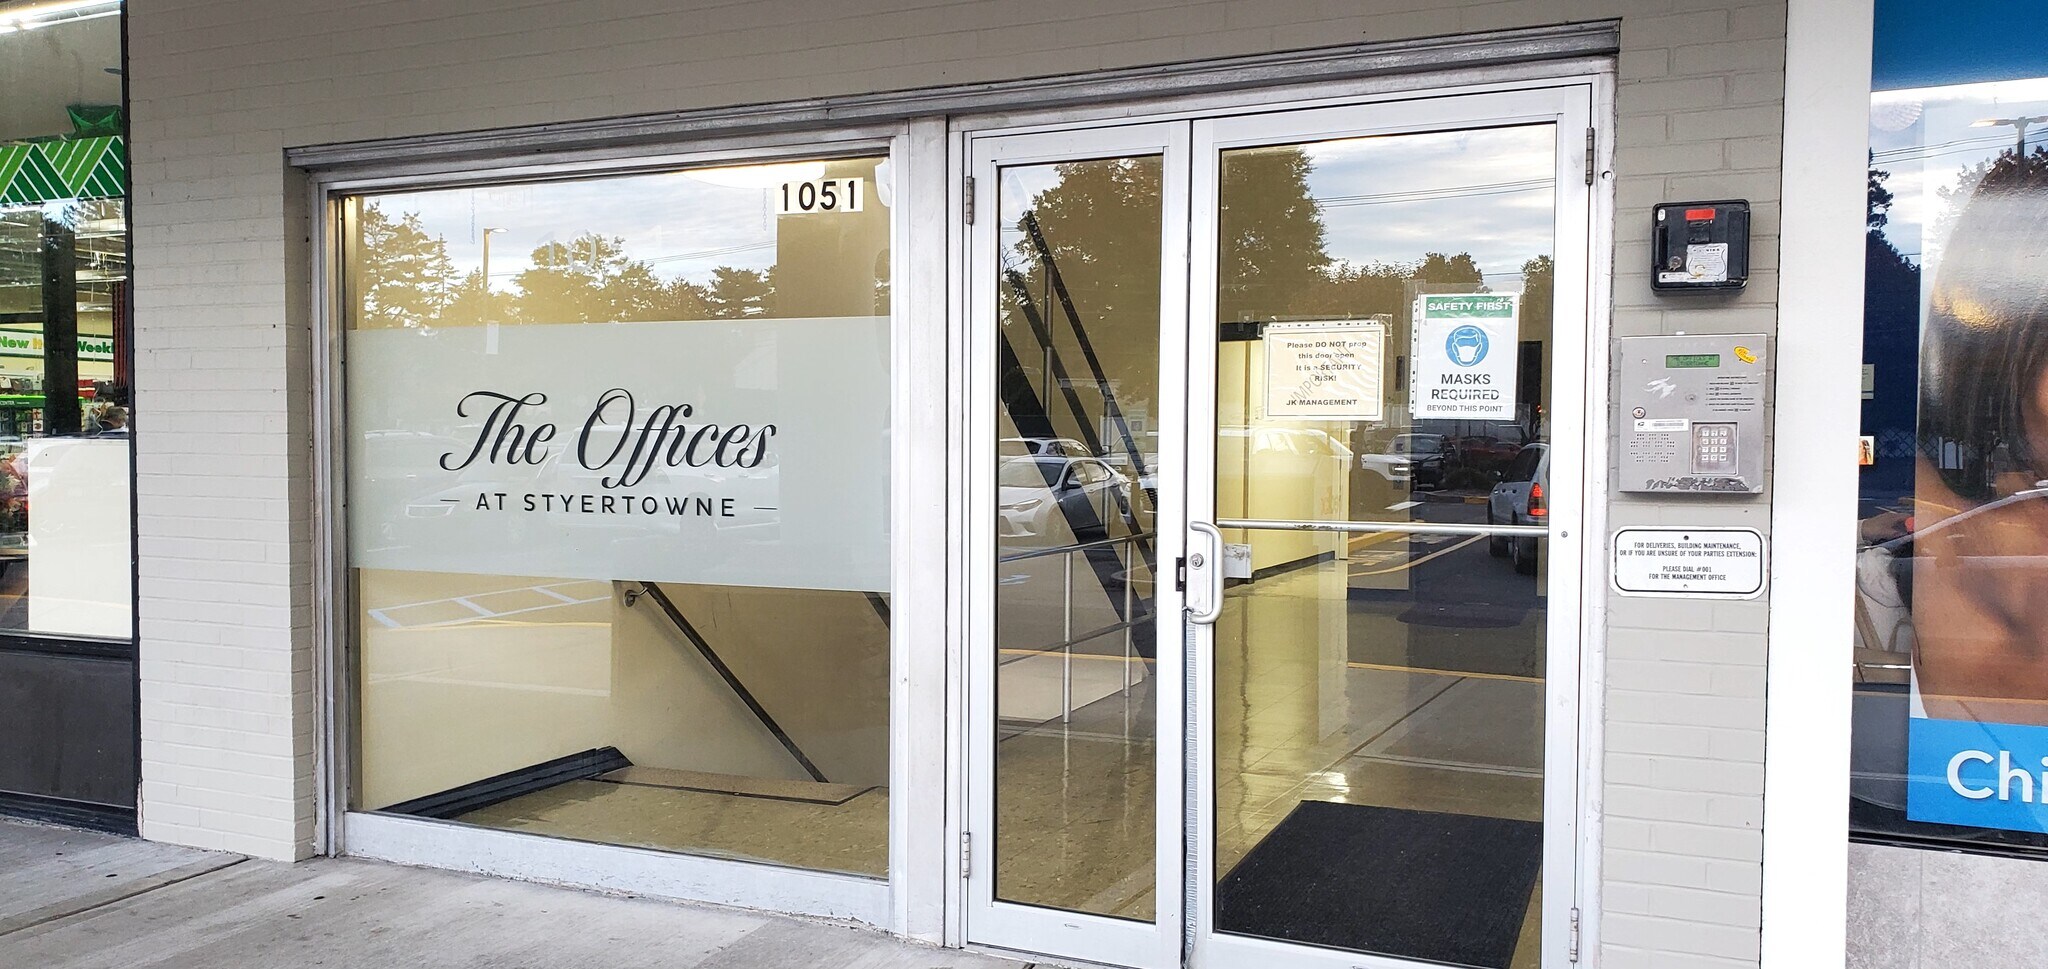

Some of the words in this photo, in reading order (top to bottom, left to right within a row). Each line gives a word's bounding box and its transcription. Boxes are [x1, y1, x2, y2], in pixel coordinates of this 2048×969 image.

[781, 180, 855, 212] 1051
[1428, 302, 1474, 311] SAFETY
[1476, 301, 1511, 310] FIRST
[0, 335, 30, 349] New
[1441, 373, 1491, 385] MASKS
[1431, 388, 1500, 401] REQUIRED
[1427, 404, 1458, 412] BEYOND
[1460, 404, 1477, 412] THIS
[439, 391, 556, 471] The
[577, 388, 777, 489] Offices
[476, 493, 507, 511] AT
[524, 493, 736, 517] STYERTOWNE
[1646, 542, 1676, 550] DELIVERIES,
[1703, 542, 1741, 550] MAINTENANCE,
[1671, 573, 1706, 581] MANAGEMENT
[1946, 749, 2048, 804] Chi
